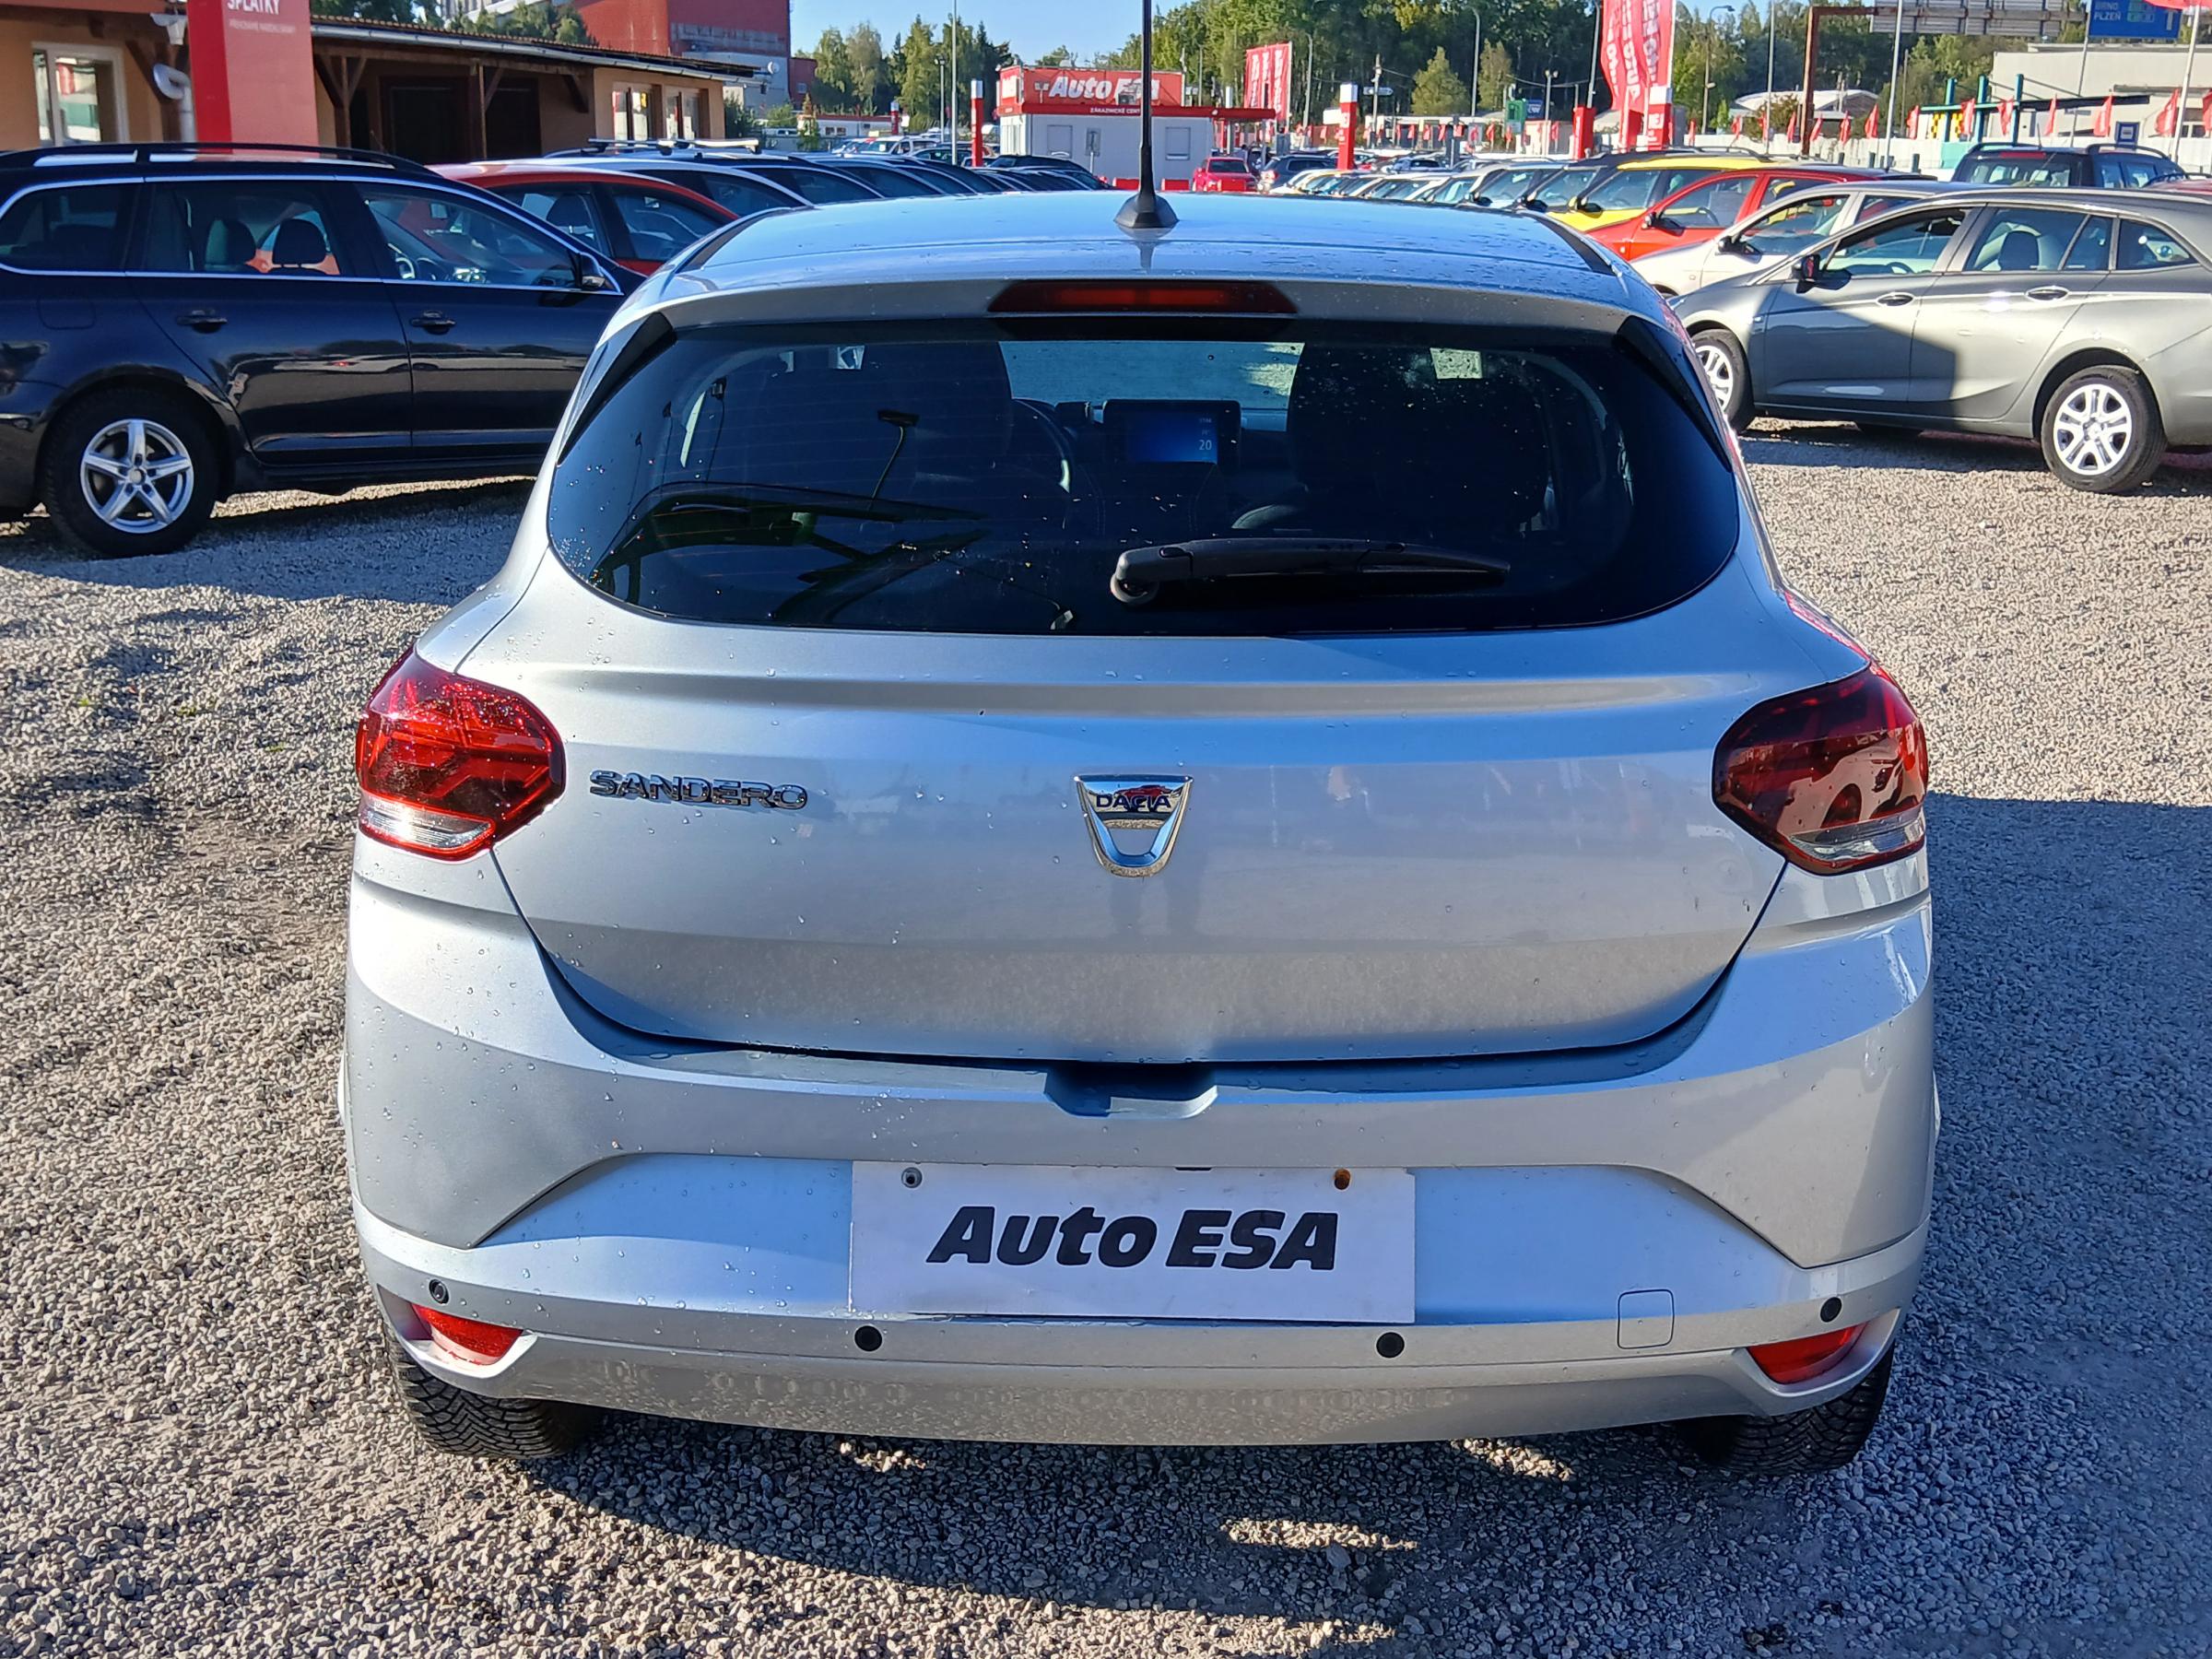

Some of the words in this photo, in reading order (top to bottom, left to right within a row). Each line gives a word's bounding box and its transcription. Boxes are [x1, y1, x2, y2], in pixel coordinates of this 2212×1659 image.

[1049, 76, 1112, 100] Auto
[1198, 439, 1212, 451] 20
[589, 770, 808, 810] SANDERO
[1096, 794, 1171, 809] DACIA
[925, 1206, 1159, 1268] Auto
[1165, 1209, 1338, 1270] ESA
